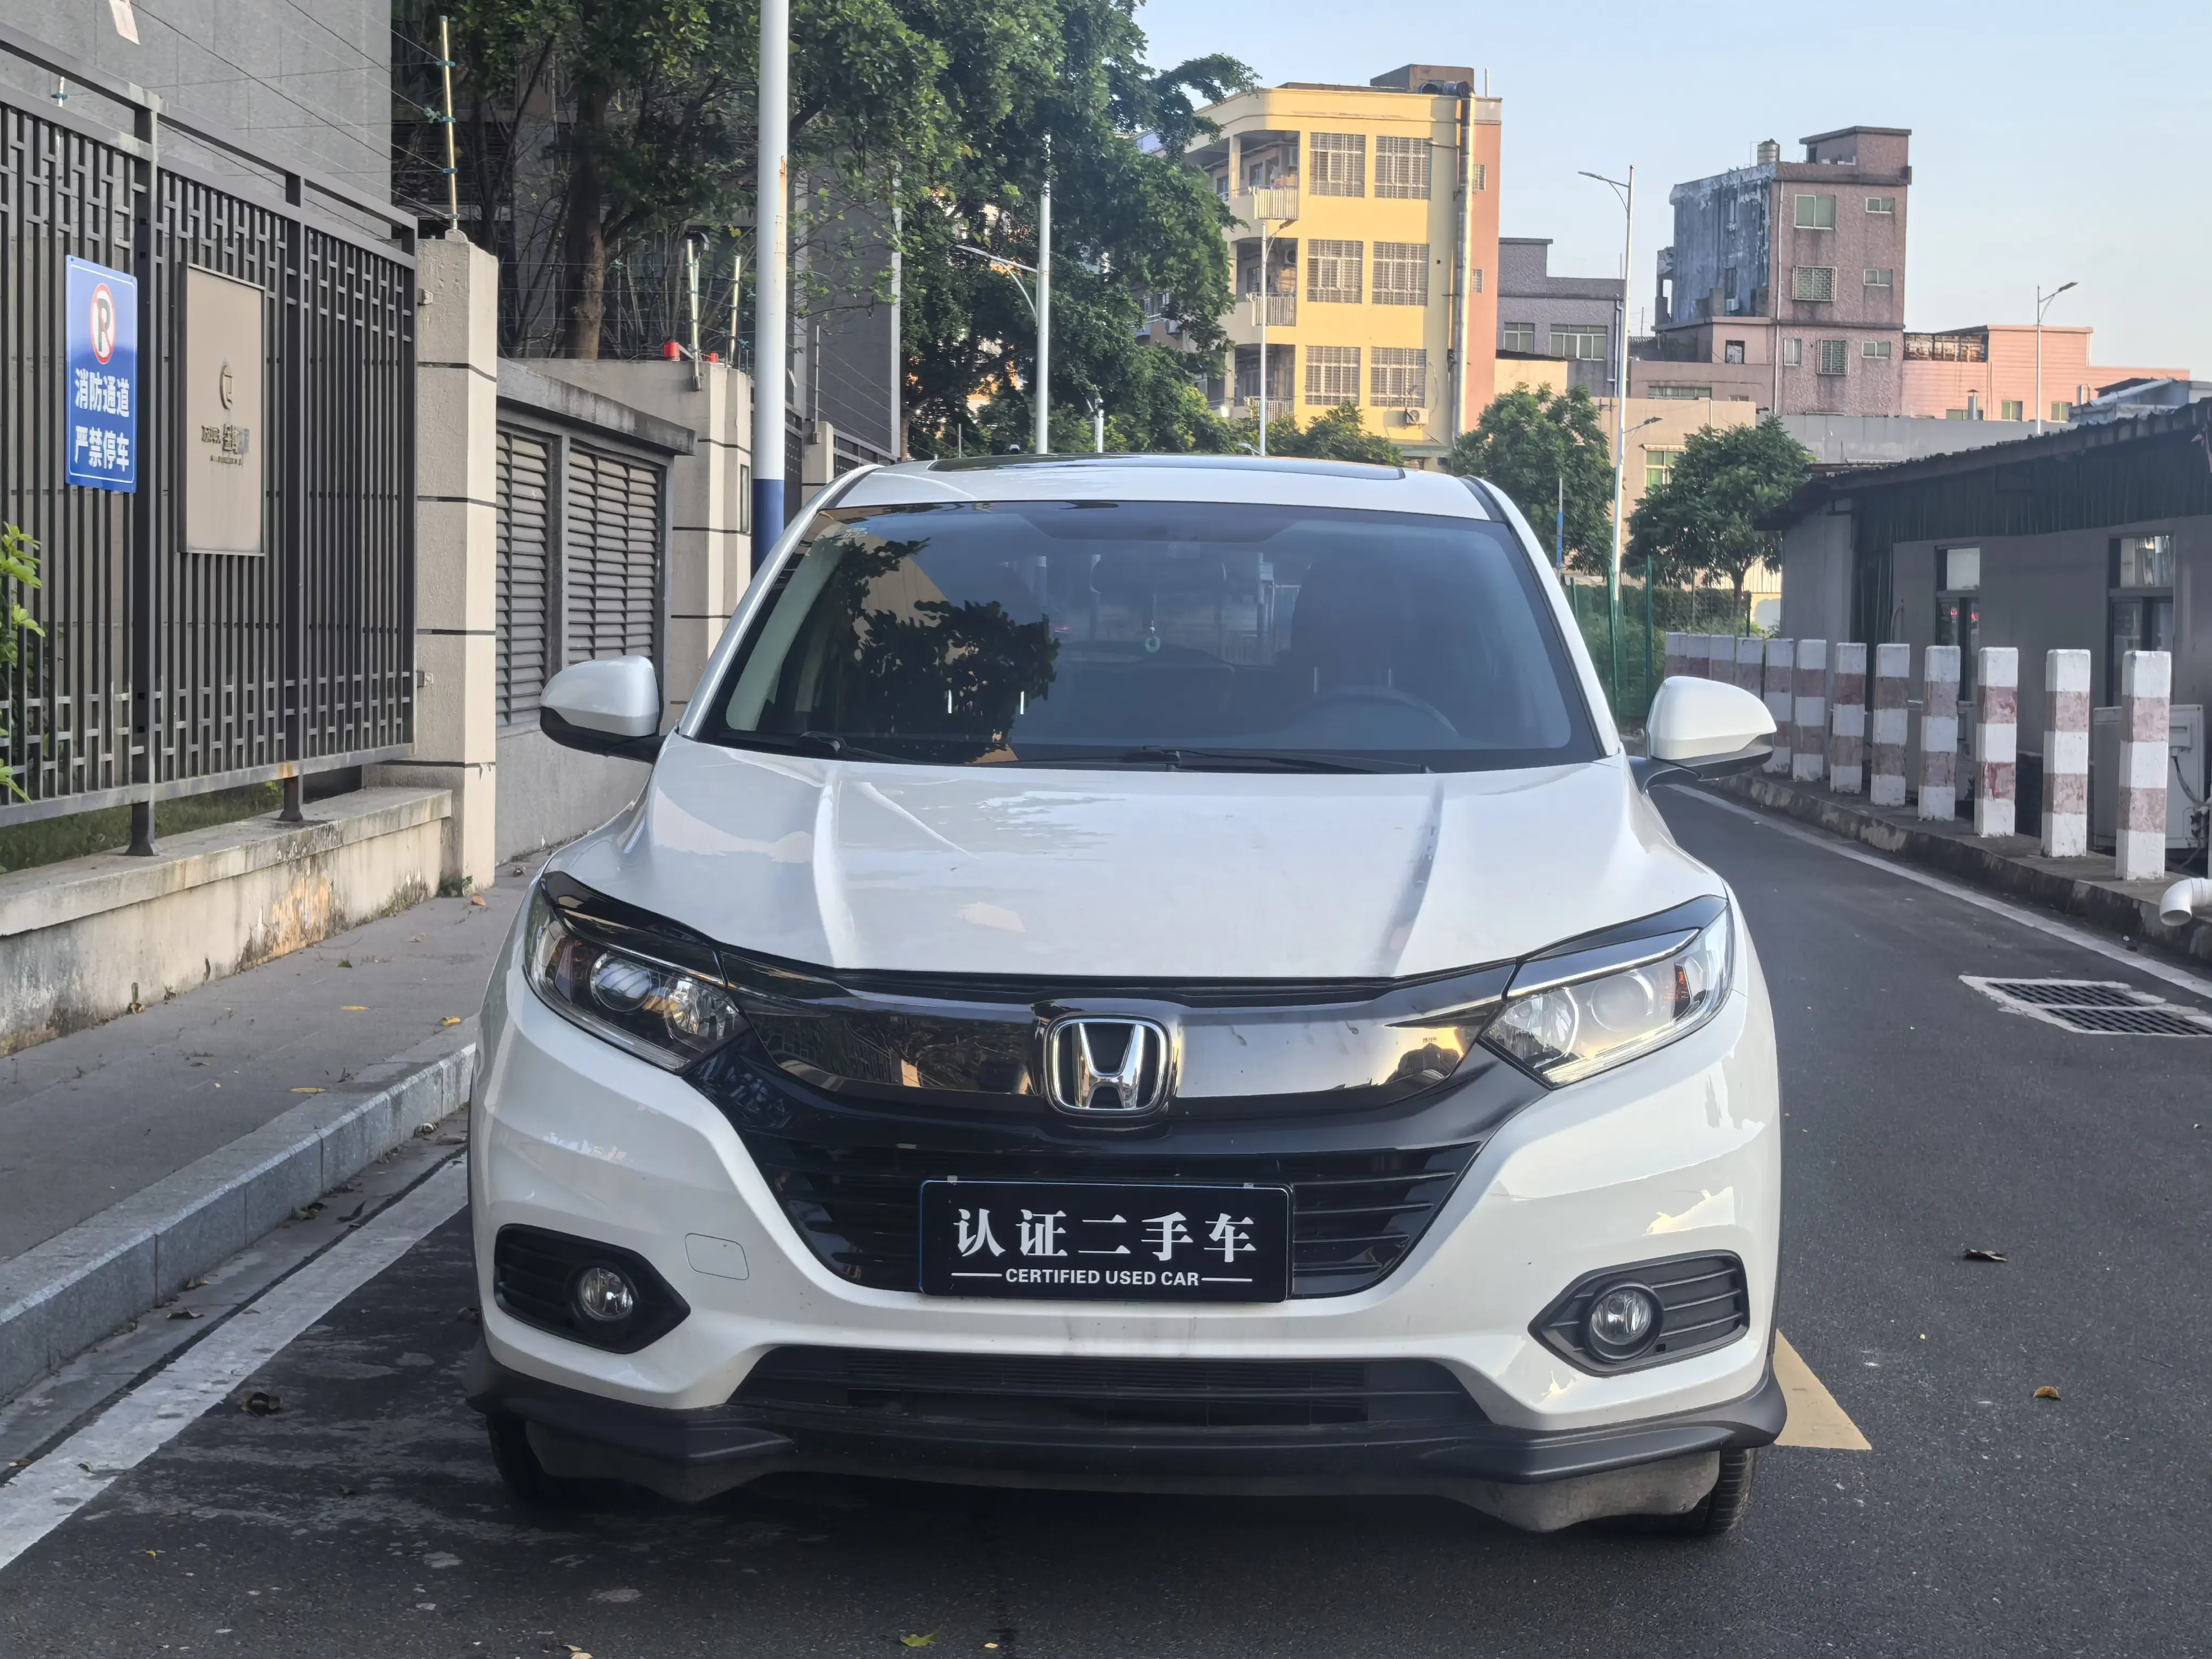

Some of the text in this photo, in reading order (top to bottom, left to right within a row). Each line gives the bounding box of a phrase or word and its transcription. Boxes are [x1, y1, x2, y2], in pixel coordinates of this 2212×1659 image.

[75, 368, 130, 417] 消防通道
[75, 425, 130, 472] 严禁停车
[953, 1208, 1257, 1263] 认证二手车
[1006, 1268, 1199, 1286] CERTIFIED USED CAR
